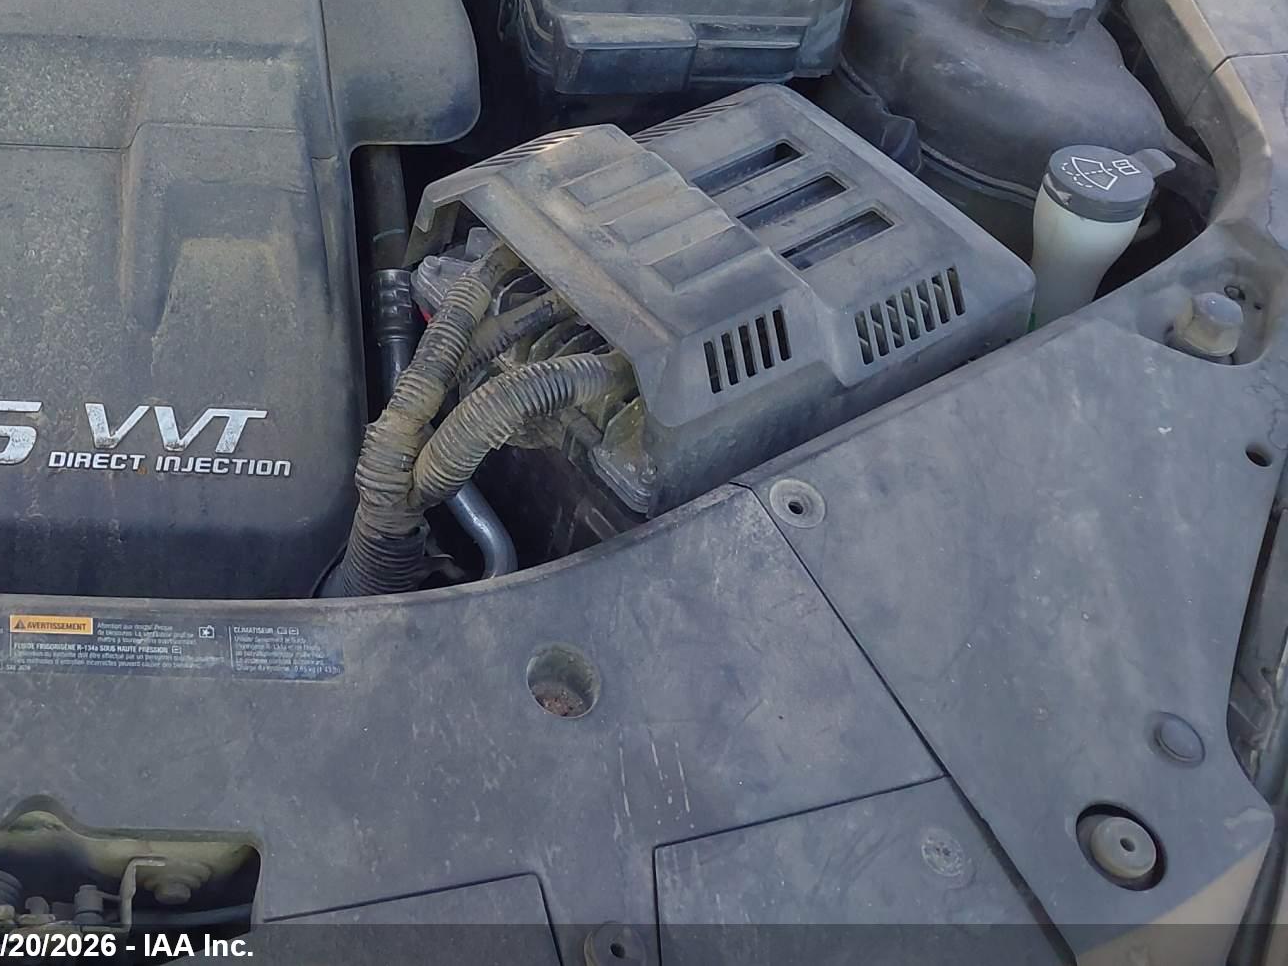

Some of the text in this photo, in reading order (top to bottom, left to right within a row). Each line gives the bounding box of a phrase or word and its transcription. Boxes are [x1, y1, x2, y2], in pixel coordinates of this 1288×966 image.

[84, 402, 268, 454] VVT
[48, 451, 292, 476] DIRECT INJECTION
[27, 621, 87, 631] AVERTISSEMENT
